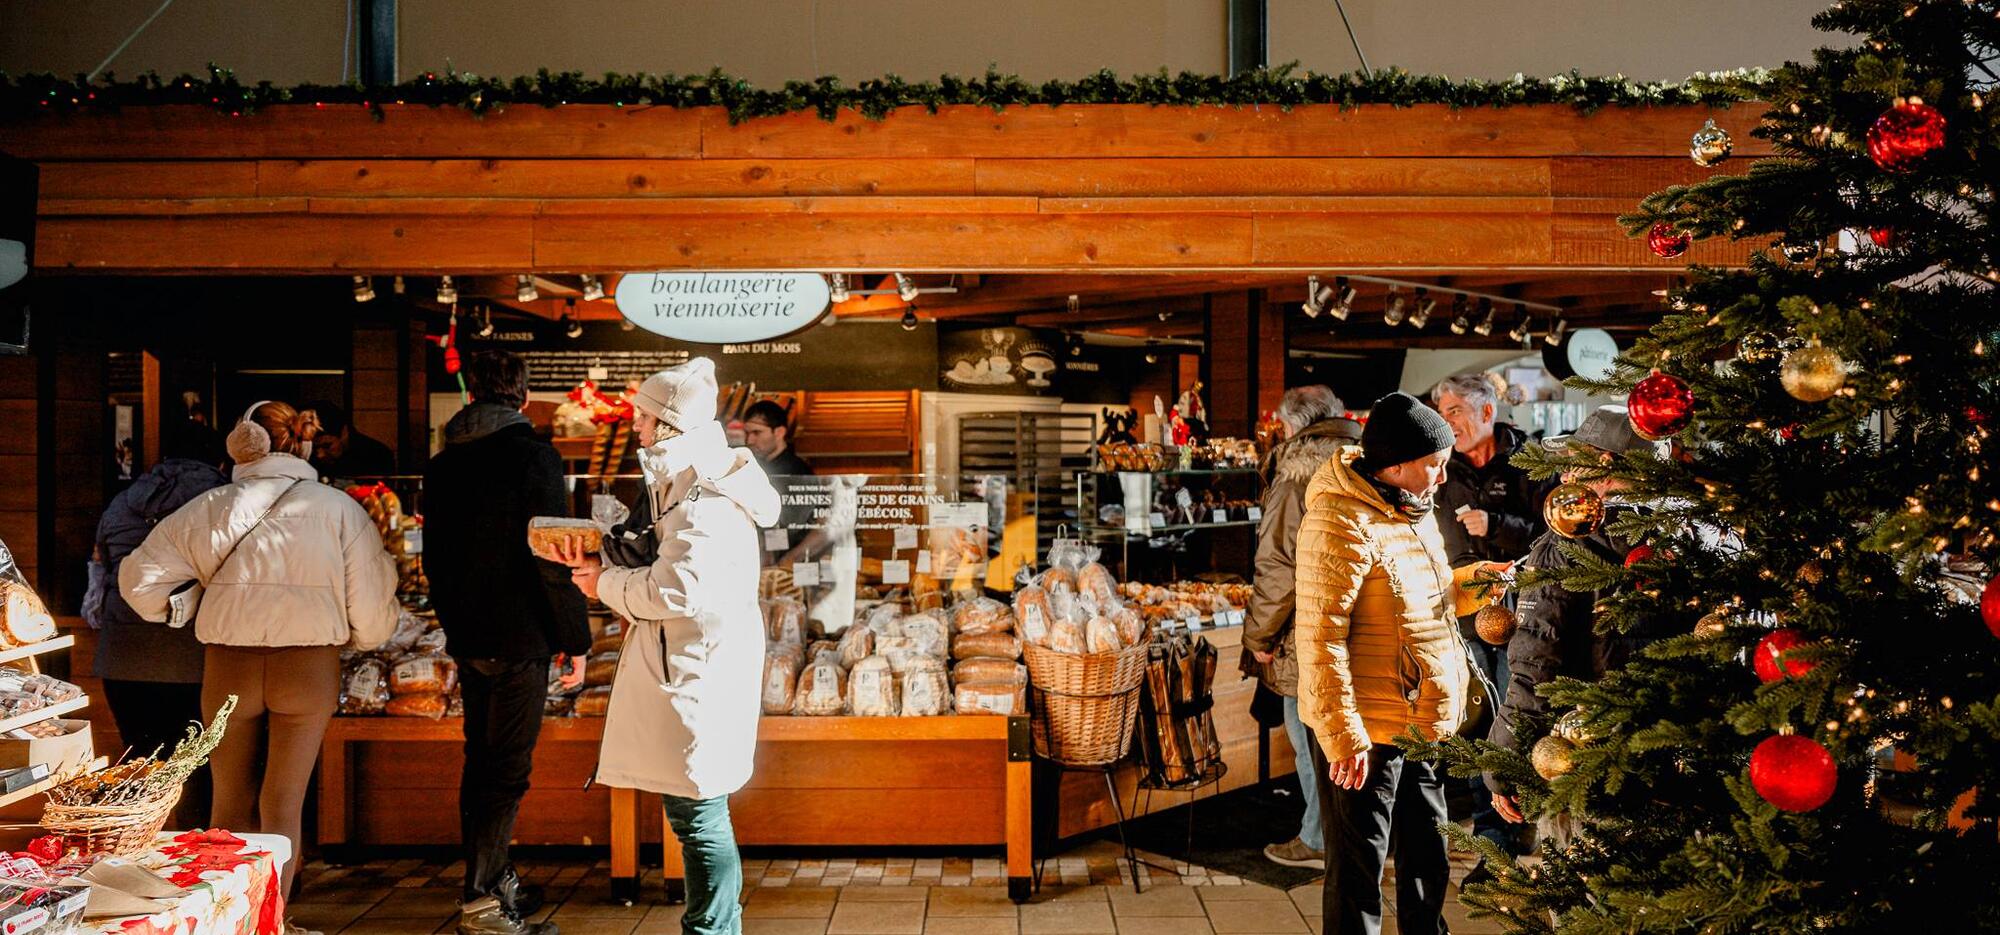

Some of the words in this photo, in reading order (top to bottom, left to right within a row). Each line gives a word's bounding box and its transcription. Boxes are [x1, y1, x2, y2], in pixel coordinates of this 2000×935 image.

[651, 272, 796, 299] boulangerie
[654, 296, 795, 317] viennoiserie
[723, 344, 750, 354] PAIN
[752, 343, 769, 353] DU
[771, 343, 801, 353] MOIS
[781, 494, 832, 505] FARINES
[879, 494, 896, 505] DE
[898, 494, 945, 505] GRAINS
